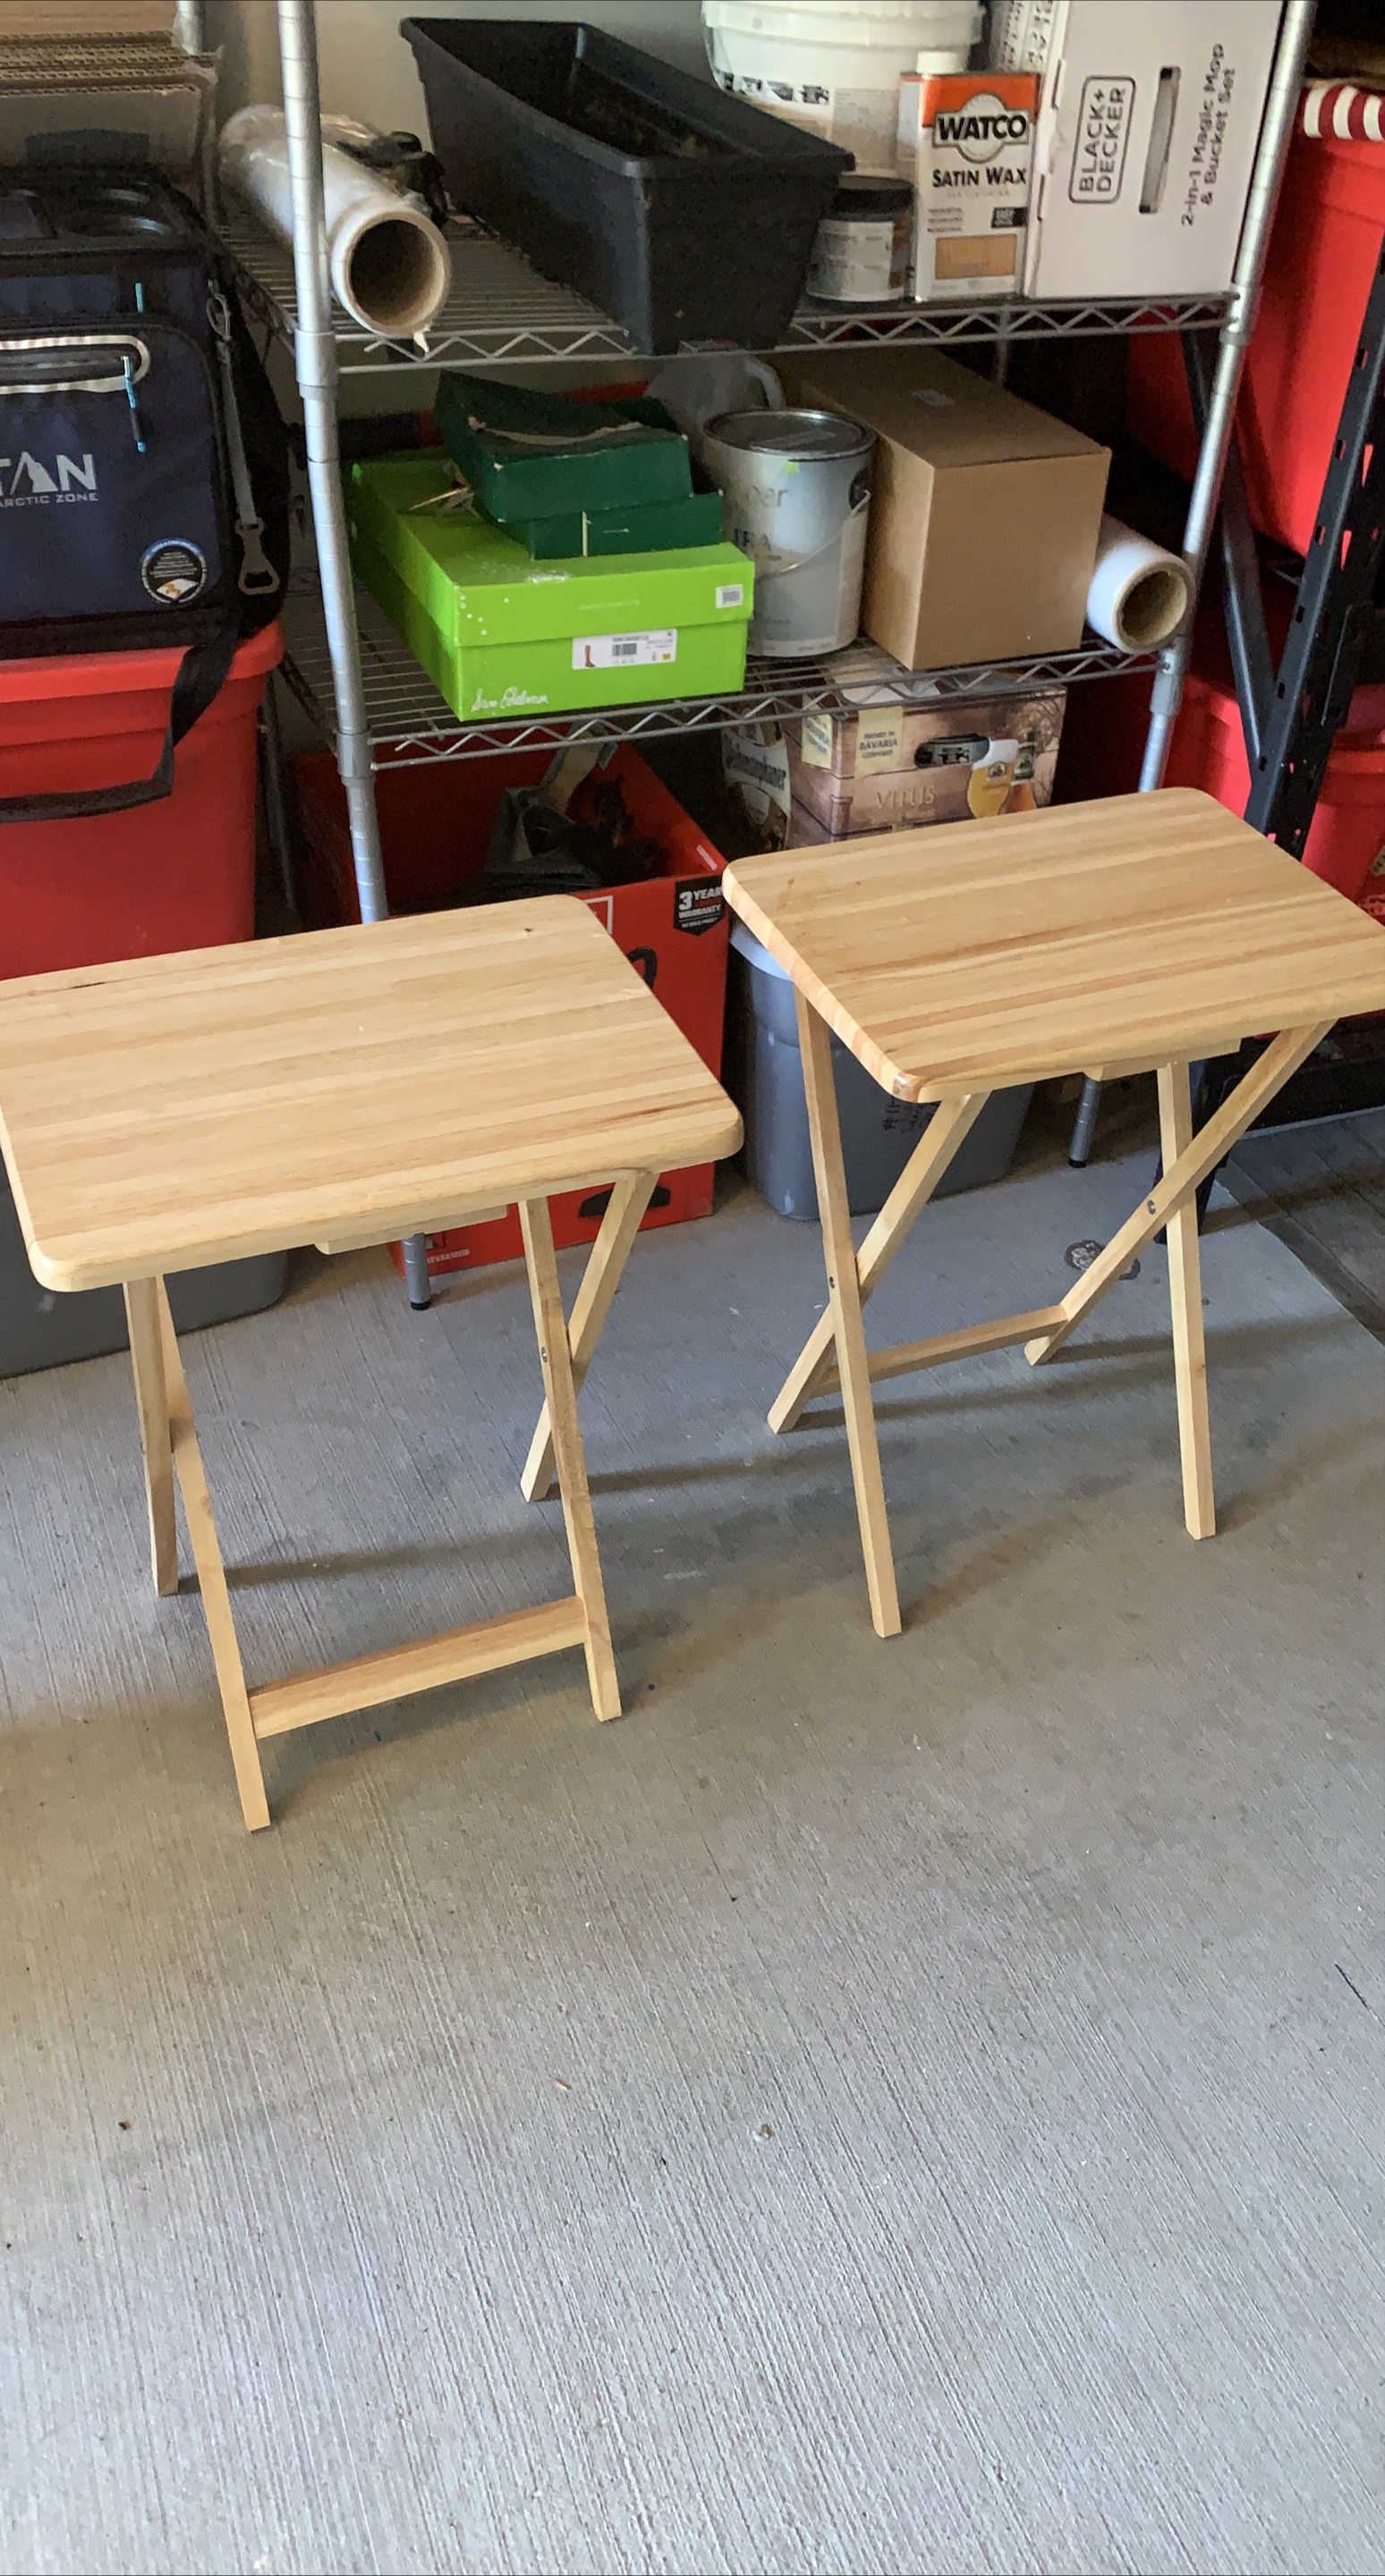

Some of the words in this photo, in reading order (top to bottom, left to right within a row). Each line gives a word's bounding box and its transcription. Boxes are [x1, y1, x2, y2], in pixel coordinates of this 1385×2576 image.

[1202, 43, 1224, 92] Mop
[938, 114, 1027, 140] WATCO
[1078, 89, 1106, 192] BLACK+
[1096, 87, 1126, 192] DECKER
[1191, 99, 1214, 164] Magic
[1203, 110, 1228, 184] Bucket
[1218, 67, 1236, 105] Set
[932, 168, 980, 188] SATIN
[985, 166, 1027, 185] WAX
[1181, 171, 1202, 226] 2-in-1
[55, 492, 98, 504] ZONE
[679, 891, 692, 911] 3
[693, 887, 722, 900] YEAR
